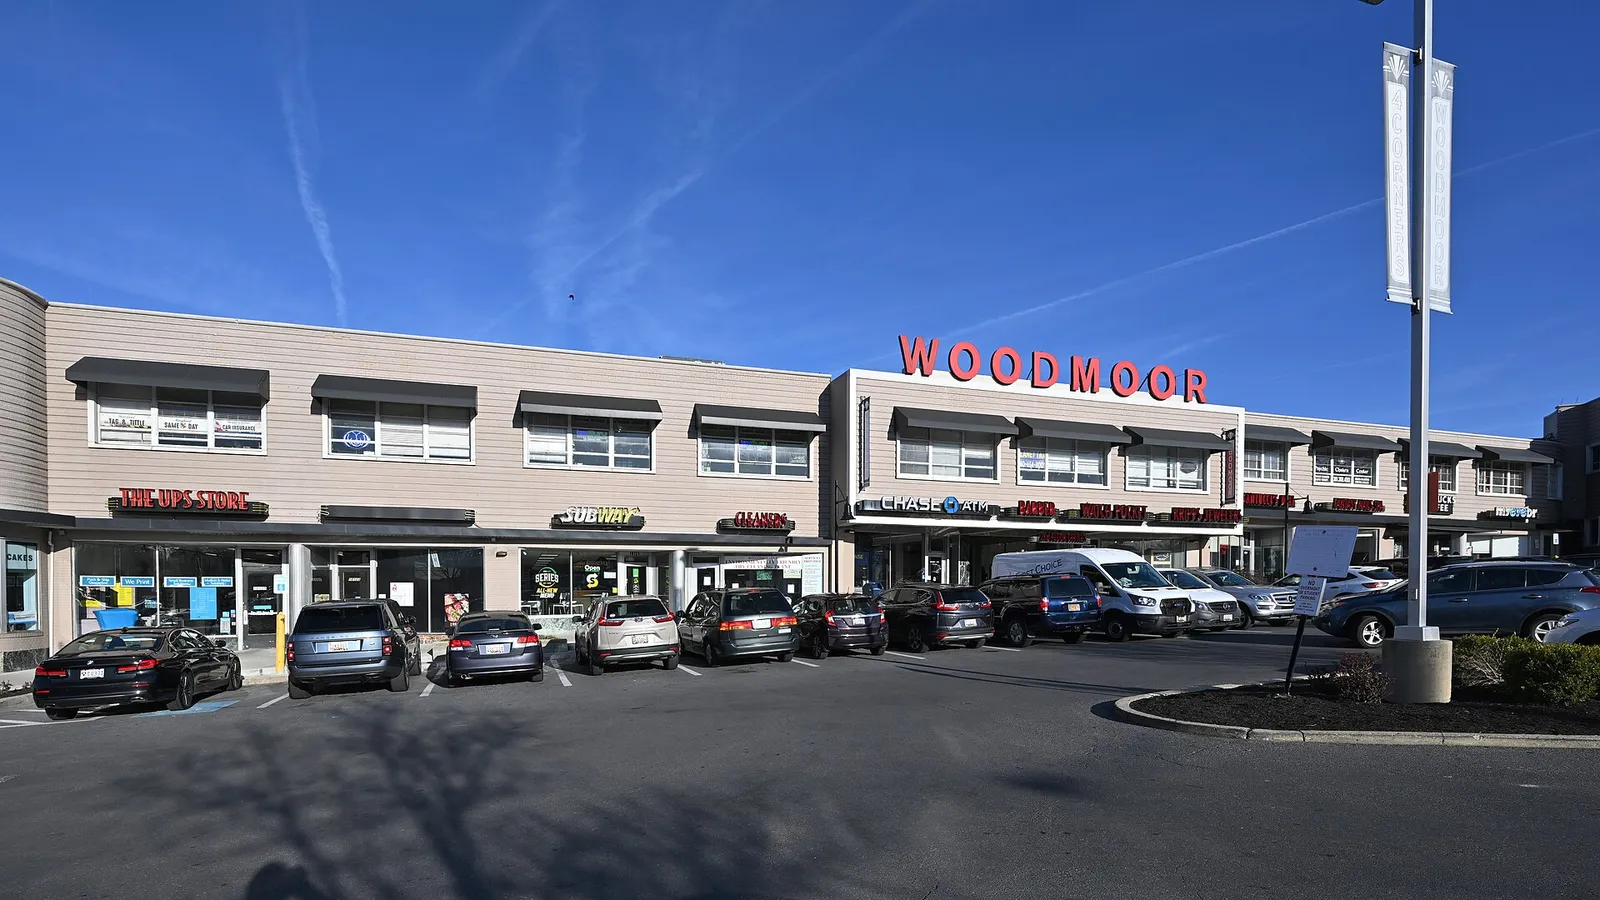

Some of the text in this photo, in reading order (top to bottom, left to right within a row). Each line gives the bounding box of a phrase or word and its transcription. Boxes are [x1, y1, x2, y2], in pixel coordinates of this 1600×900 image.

[898, 334, 1208, 404] WOODMOOR
[164, 421, 180, 429] SAME
[119, 488, 249, 510] THE UPS STORE
[881, 496, 989, 512] CHASE ATM
[560, 506, 640, 524] SUBWAY
[1018, 500, 1056, 516] BARBER
[735, 511, 788, 528] CLEANERS
[7, 553, 34, 562] CAKES
[584, 564, 601, 572] Open
[1035, 558, 1063, 574] CHOICE
[535, 573, 559, 583] SERIES
